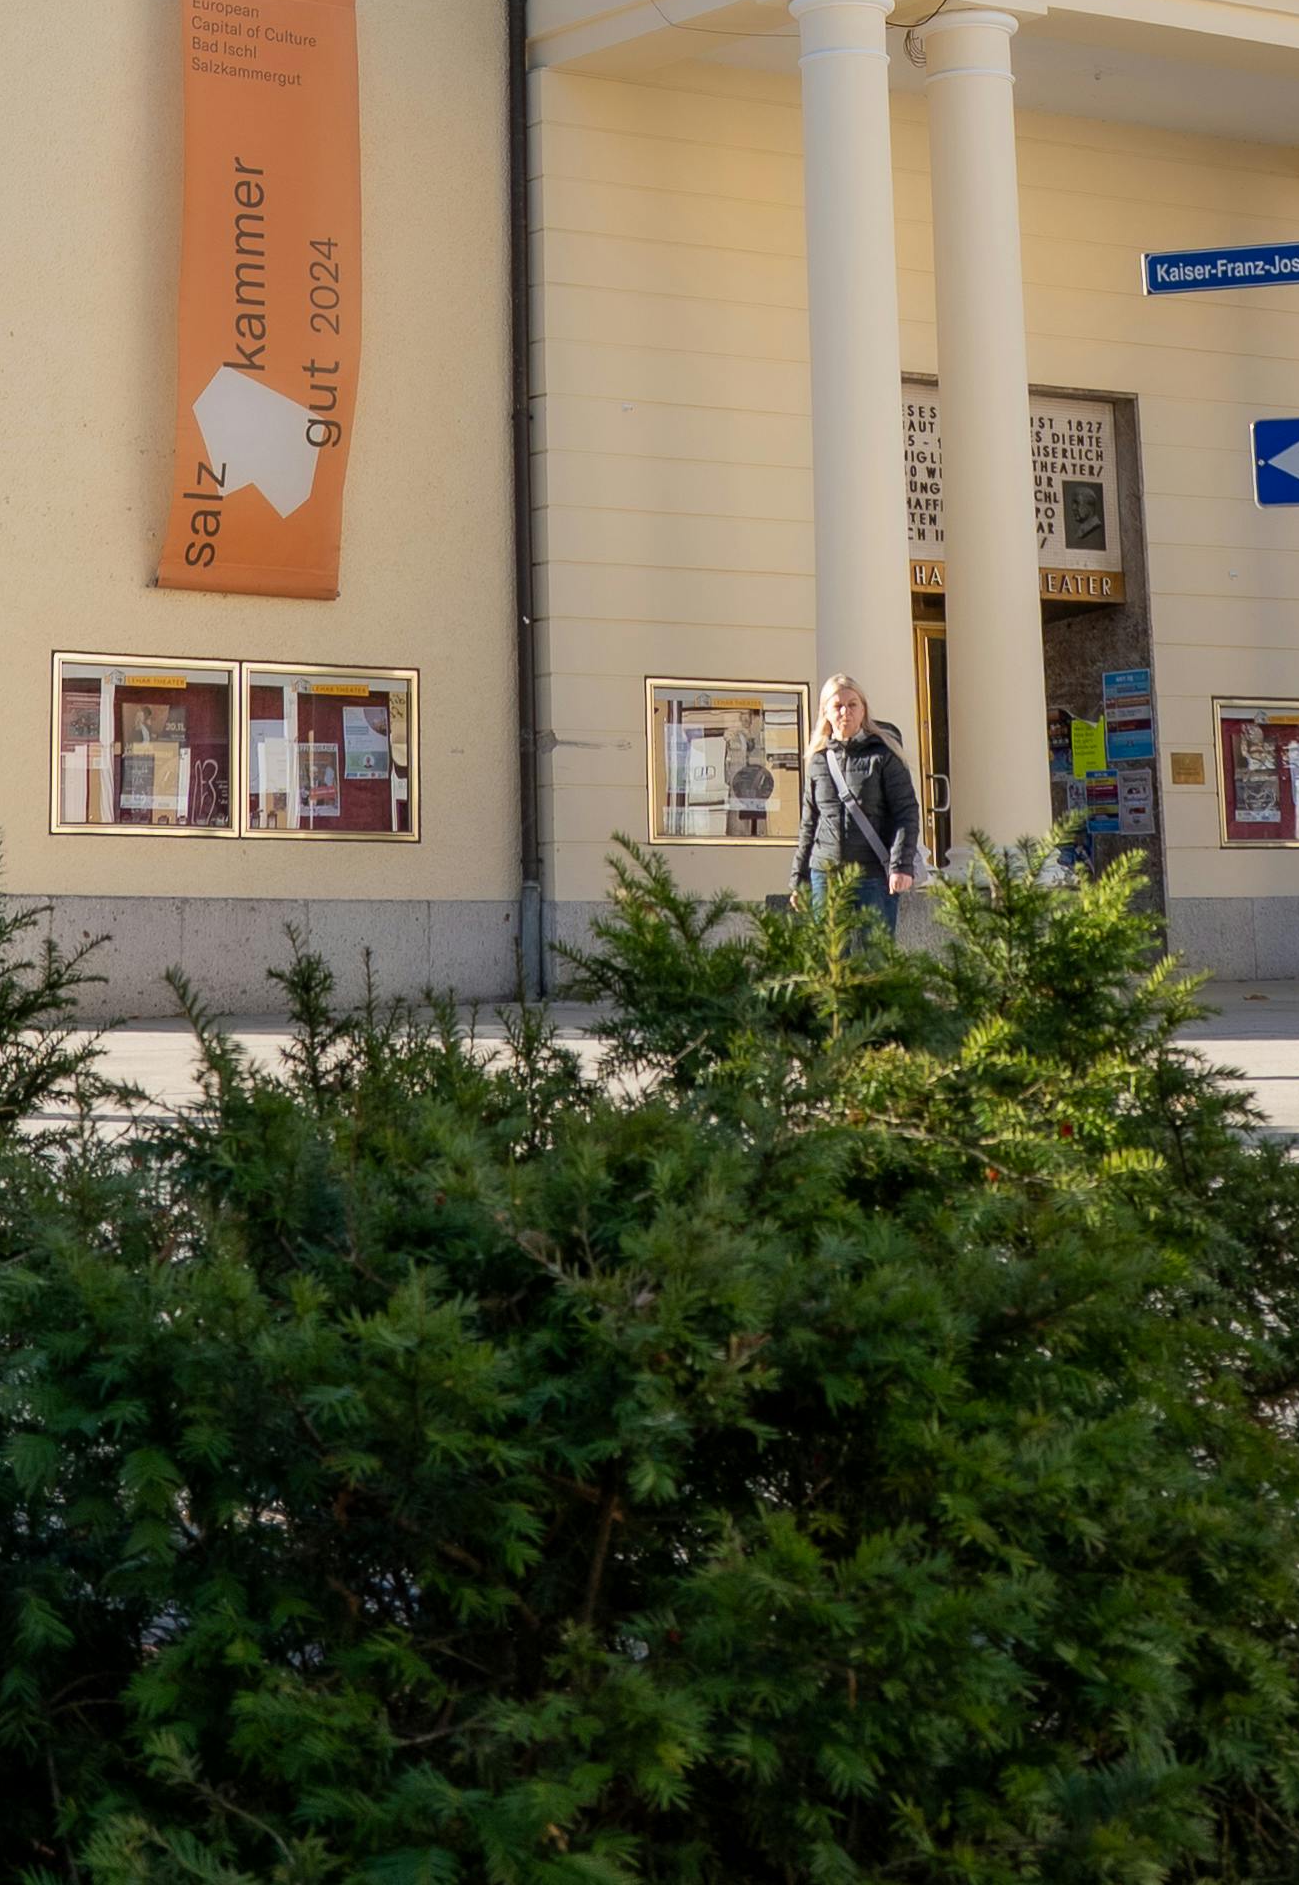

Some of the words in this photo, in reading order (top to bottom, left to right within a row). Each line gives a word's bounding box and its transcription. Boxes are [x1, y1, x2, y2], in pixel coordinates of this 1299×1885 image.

[191, 15, 242, 36] Capital
[247, 26, 261, 39] of
[264, 27, 317, 47] Culture
[192, 36, 218, 53] Bad
[223, 41, 257, 59] Ischl
[191, 56, 302, 87] Salzkammergut
[222, 156, 265, 372] kammer
[308, 236, 341, 335] 2024
[302, 358, 342, 448] gut
[902, 405, 937, 419] SES
[1067, 420, 1103, 433] 1827
[1052, 433, 1103, 449] DIENTE
[183, 461, 228, 568] salz
[1039, 574, 1112, 596] EATER
